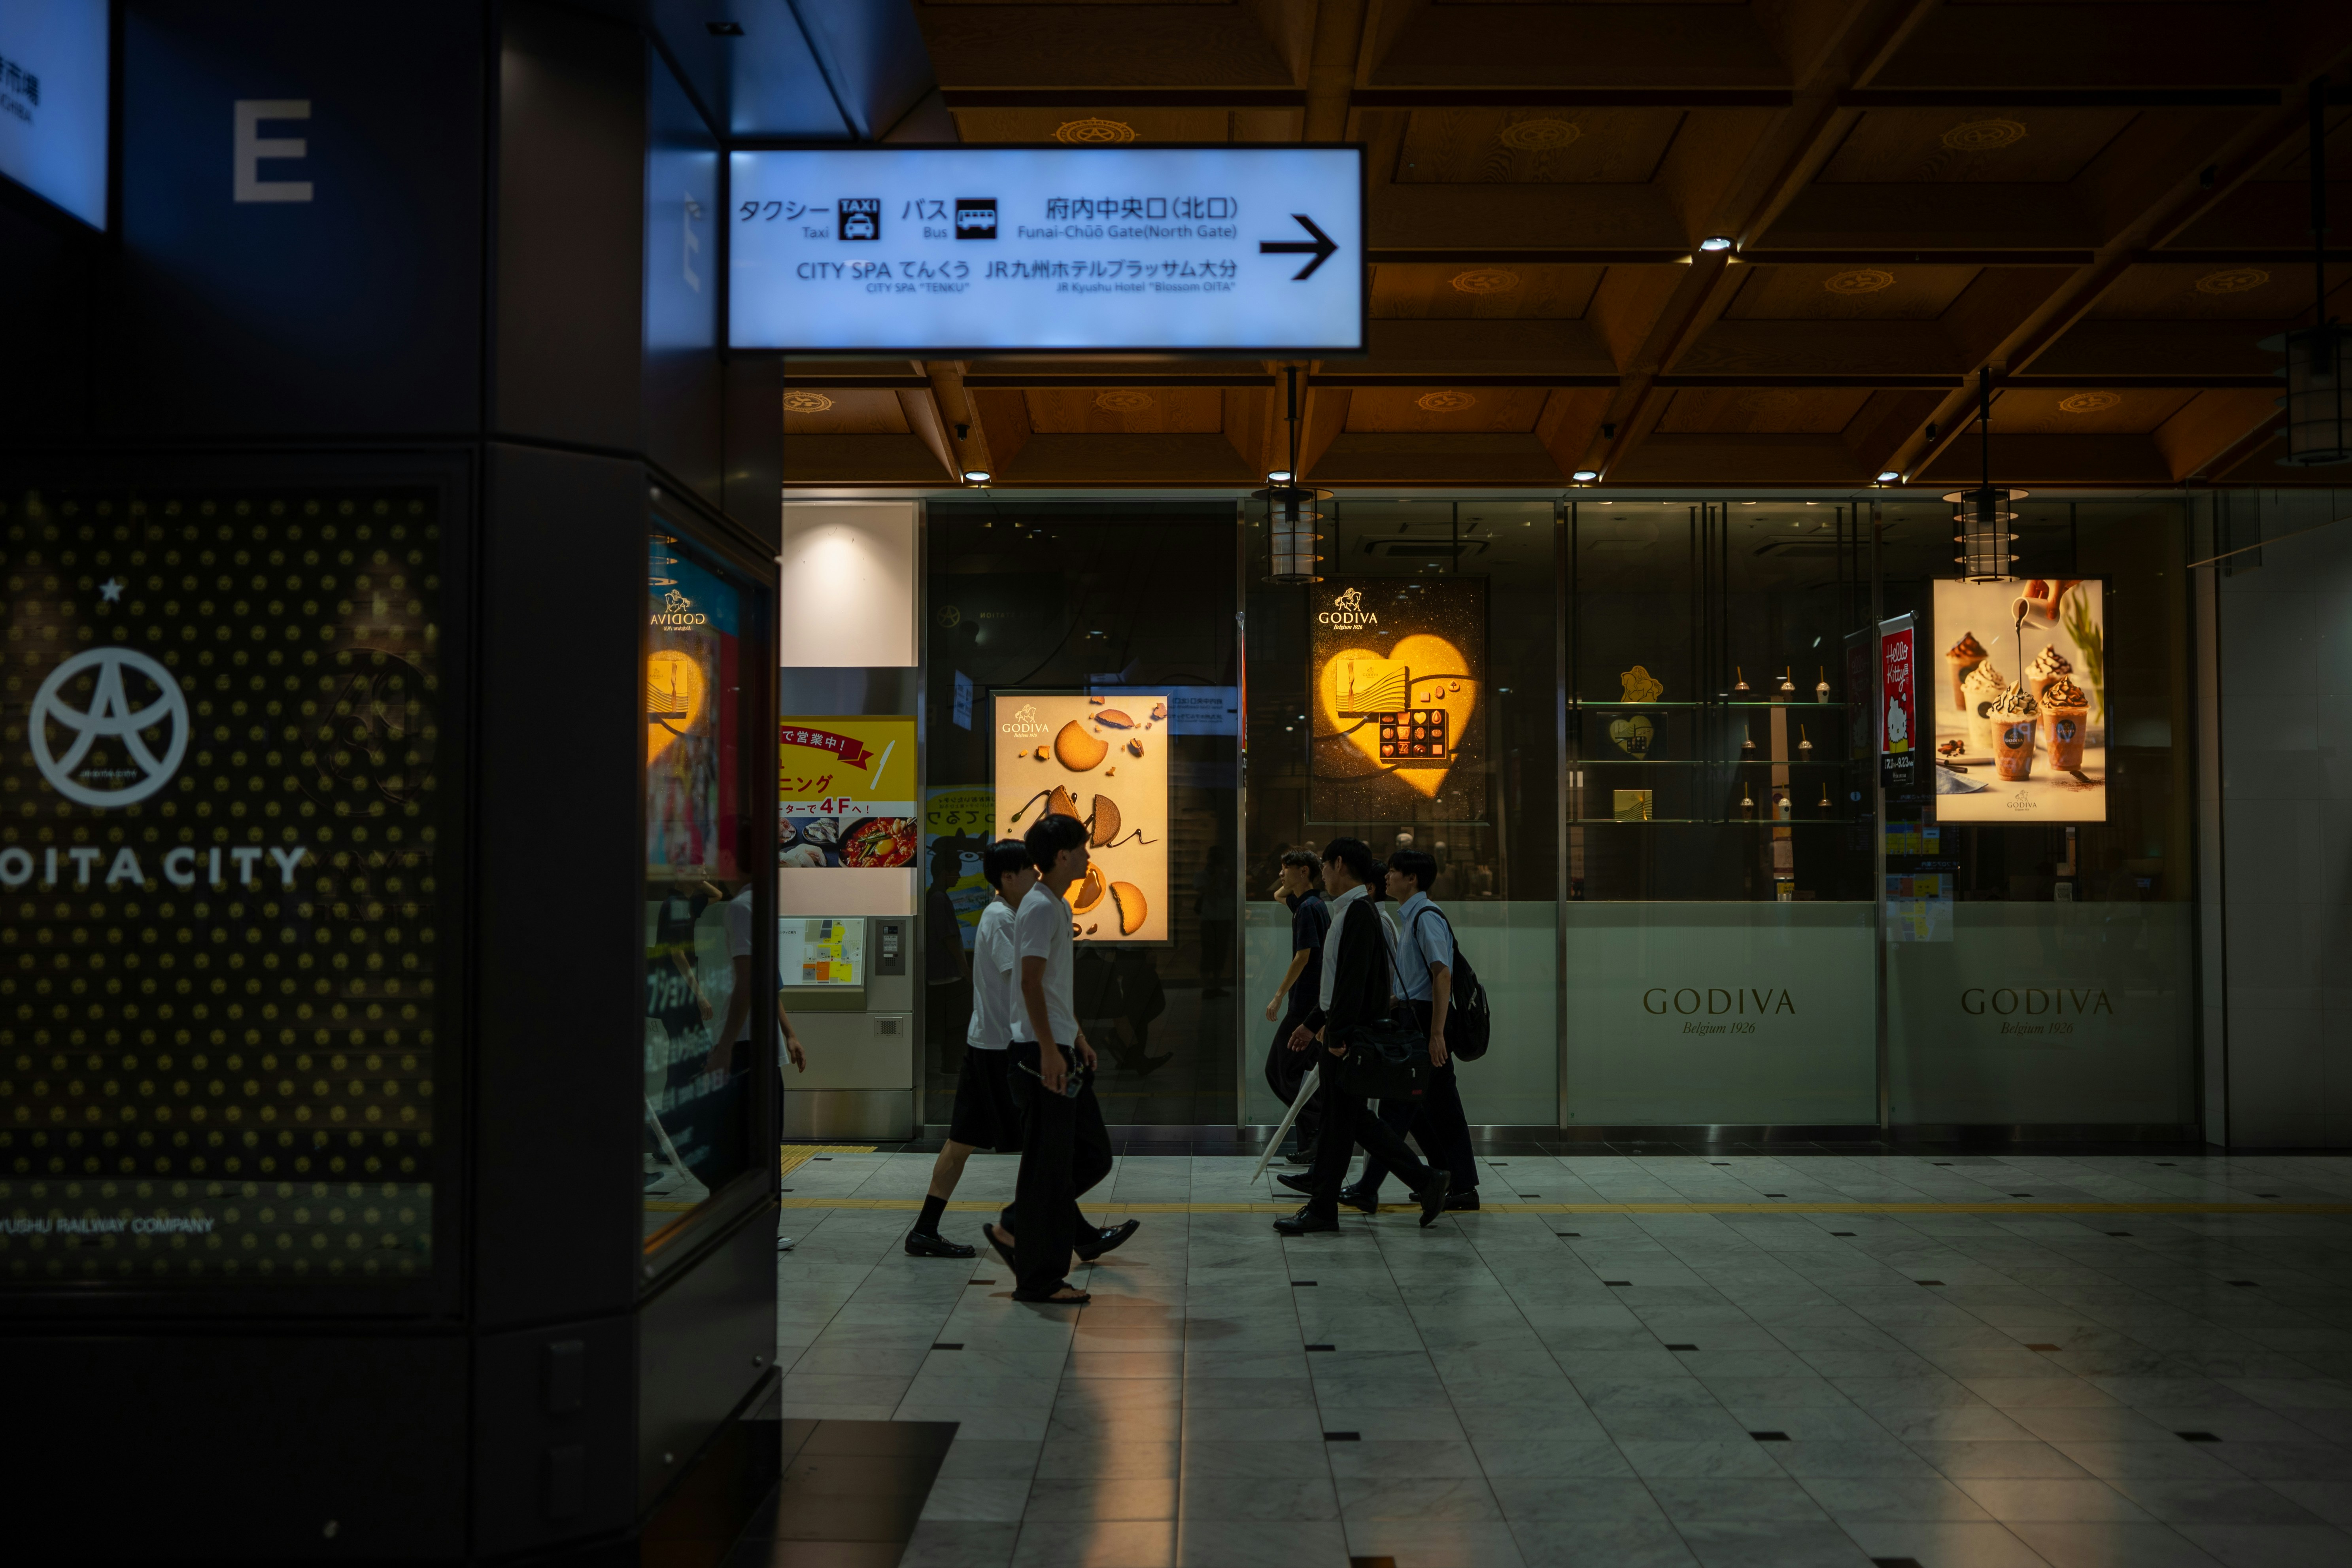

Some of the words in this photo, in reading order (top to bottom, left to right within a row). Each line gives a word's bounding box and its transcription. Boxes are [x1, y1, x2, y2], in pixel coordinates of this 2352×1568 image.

[234, 100, 312, 201] E
[740, 200, 829, 221] タクシー
[841, 200, 878, 212] TAXI
[901, 198, 947, 220] バス
[1047, 197, 1238, 220] 府内中央口（北口）
[802, 227, 828, 238] Taxi
[924, 227, 947, 238] Bus
[1018, 224, 1104, 238] Funai-Chūō
[1197, 225, 1237, 239] Gate)
[797, 262, 843, 279] CITY
[851, 262, 892, 279] SPA
[899, 261, 969, 279] てんくう
[986, 259, 1238, 278] JR九州ホテルブラッサム大分
[867, 283, 892, 293] CITY
[895, 283, 915, 293] SPA
[1057, 283, 1069, 293] JR
[1072, 283, 1111, 295] Kyushu
[1115, 282, 1145, 292] Hotel
[1319, 612, 1377, 623] GODIVA
[1886, 641, 1908, 664] Hello
[1887, 663, 1905, 692] Kitty
[1002, 724, 1049, 733] GODIVA
[778, 731, 845, 751] で営業中！
[1400, 743, 1408, 752] 72
[0, 848, 144, 885] OITA
[164, 848, 306, 885] CITY
[1643, 988, 1796, 1014] GODIVA
[1961, 988, 2114, 1014] GODIVA
[1683, 1021, 1728, 1037] Belgium
[1730, 1022, 1755, 1034] 1926
[2001, 1021, 2045, 1037] Belgium
[2048, 1022, 2073, 1034] 1926
[56, 1217, 127, 1234] RAILWAY
[132, 1217, 214, 1234] COMPANY
